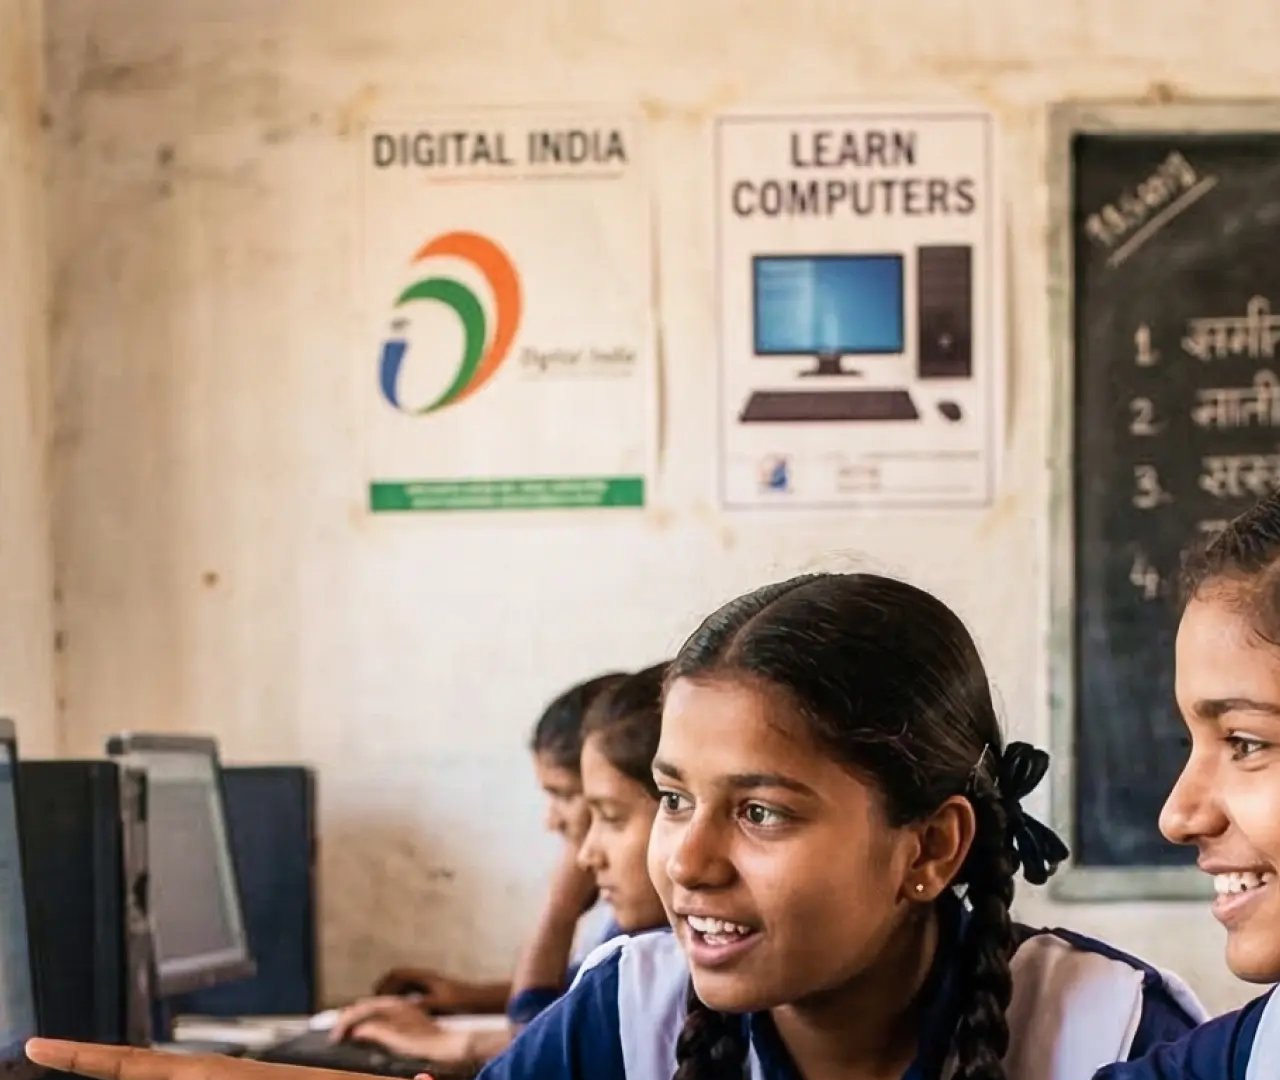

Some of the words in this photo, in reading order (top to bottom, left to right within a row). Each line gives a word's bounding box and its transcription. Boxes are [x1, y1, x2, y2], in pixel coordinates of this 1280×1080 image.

[373, 132, 514, 167] DIGITAL
[528, 129, 626, 163] INDIA
[790, 131, 917, 167] LEARN
[731, 177, 976, 218] COMPUTERS
